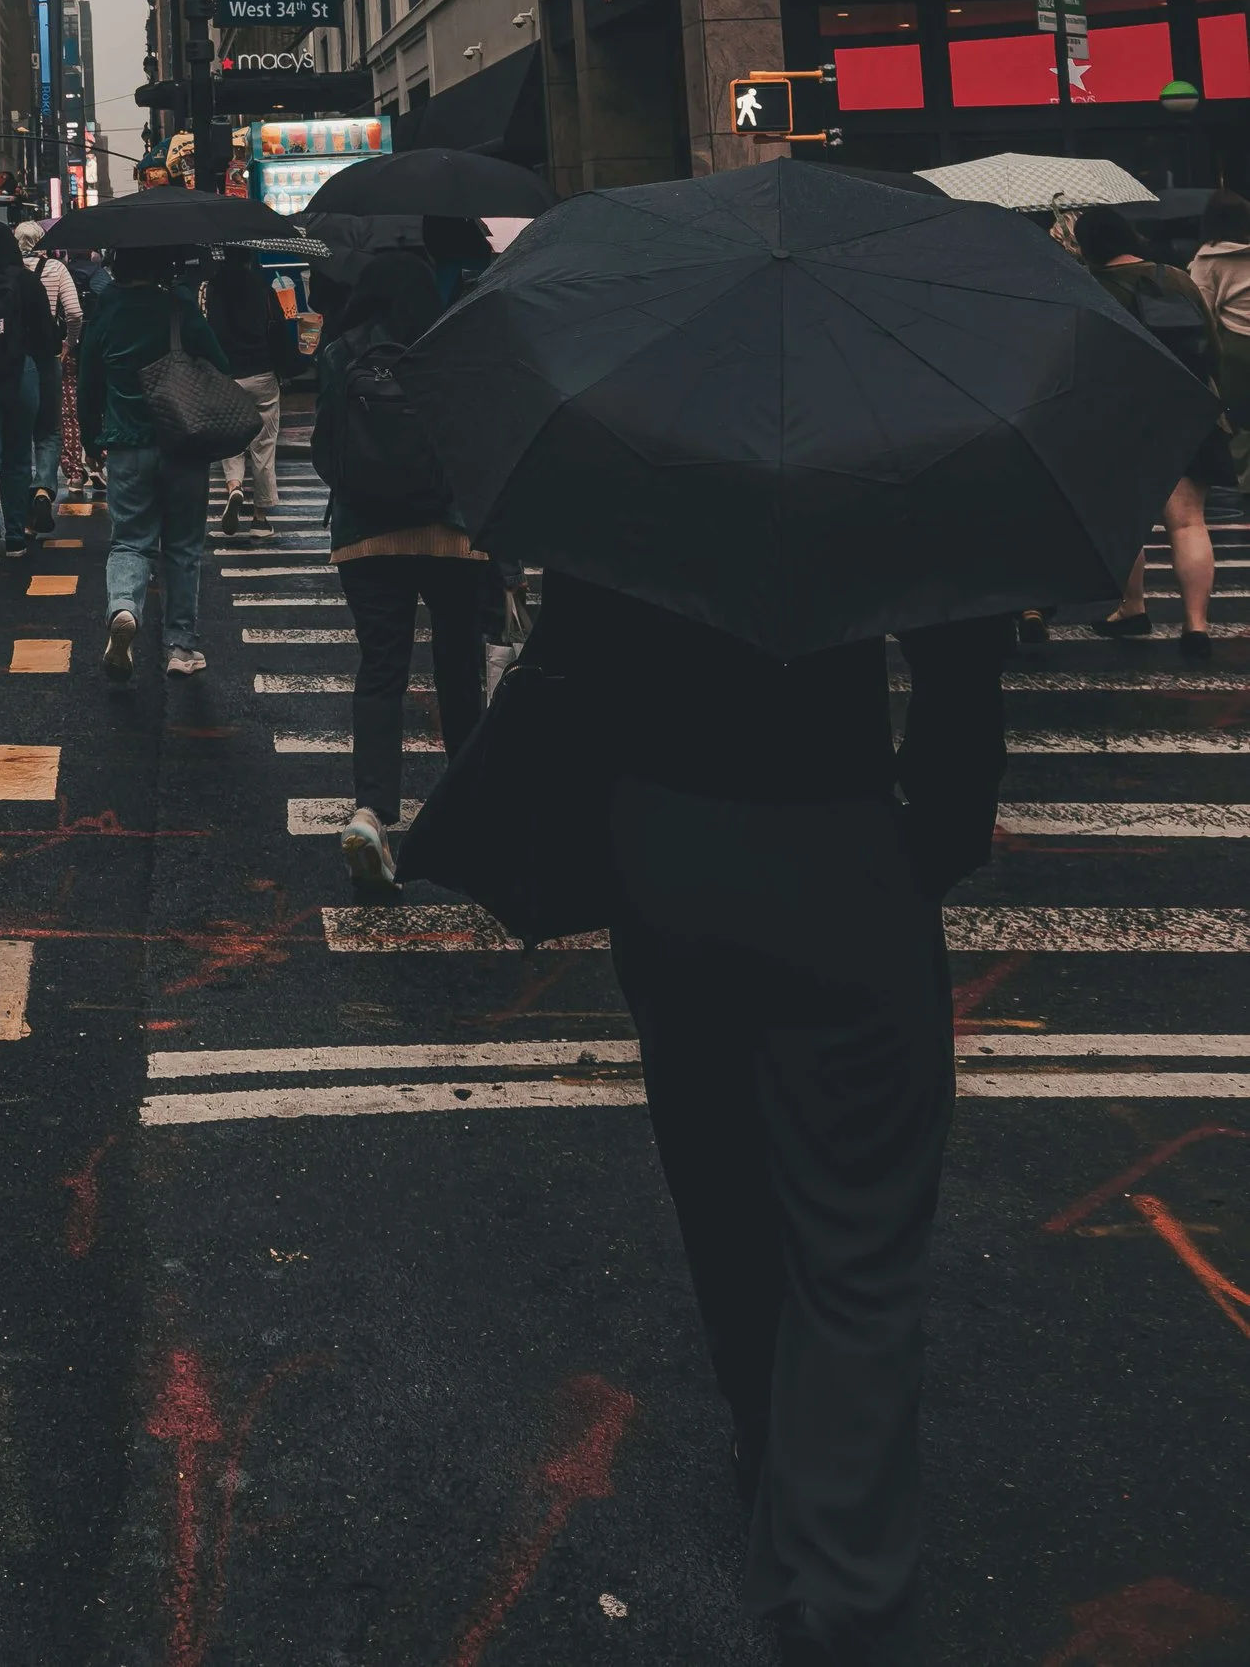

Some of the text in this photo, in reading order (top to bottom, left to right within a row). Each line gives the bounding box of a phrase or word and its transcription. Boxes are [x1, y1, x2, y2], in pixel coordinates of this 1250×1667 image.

[229, 0, 329, 18] West 34th St
[238, 48, 315, 74] macy's
